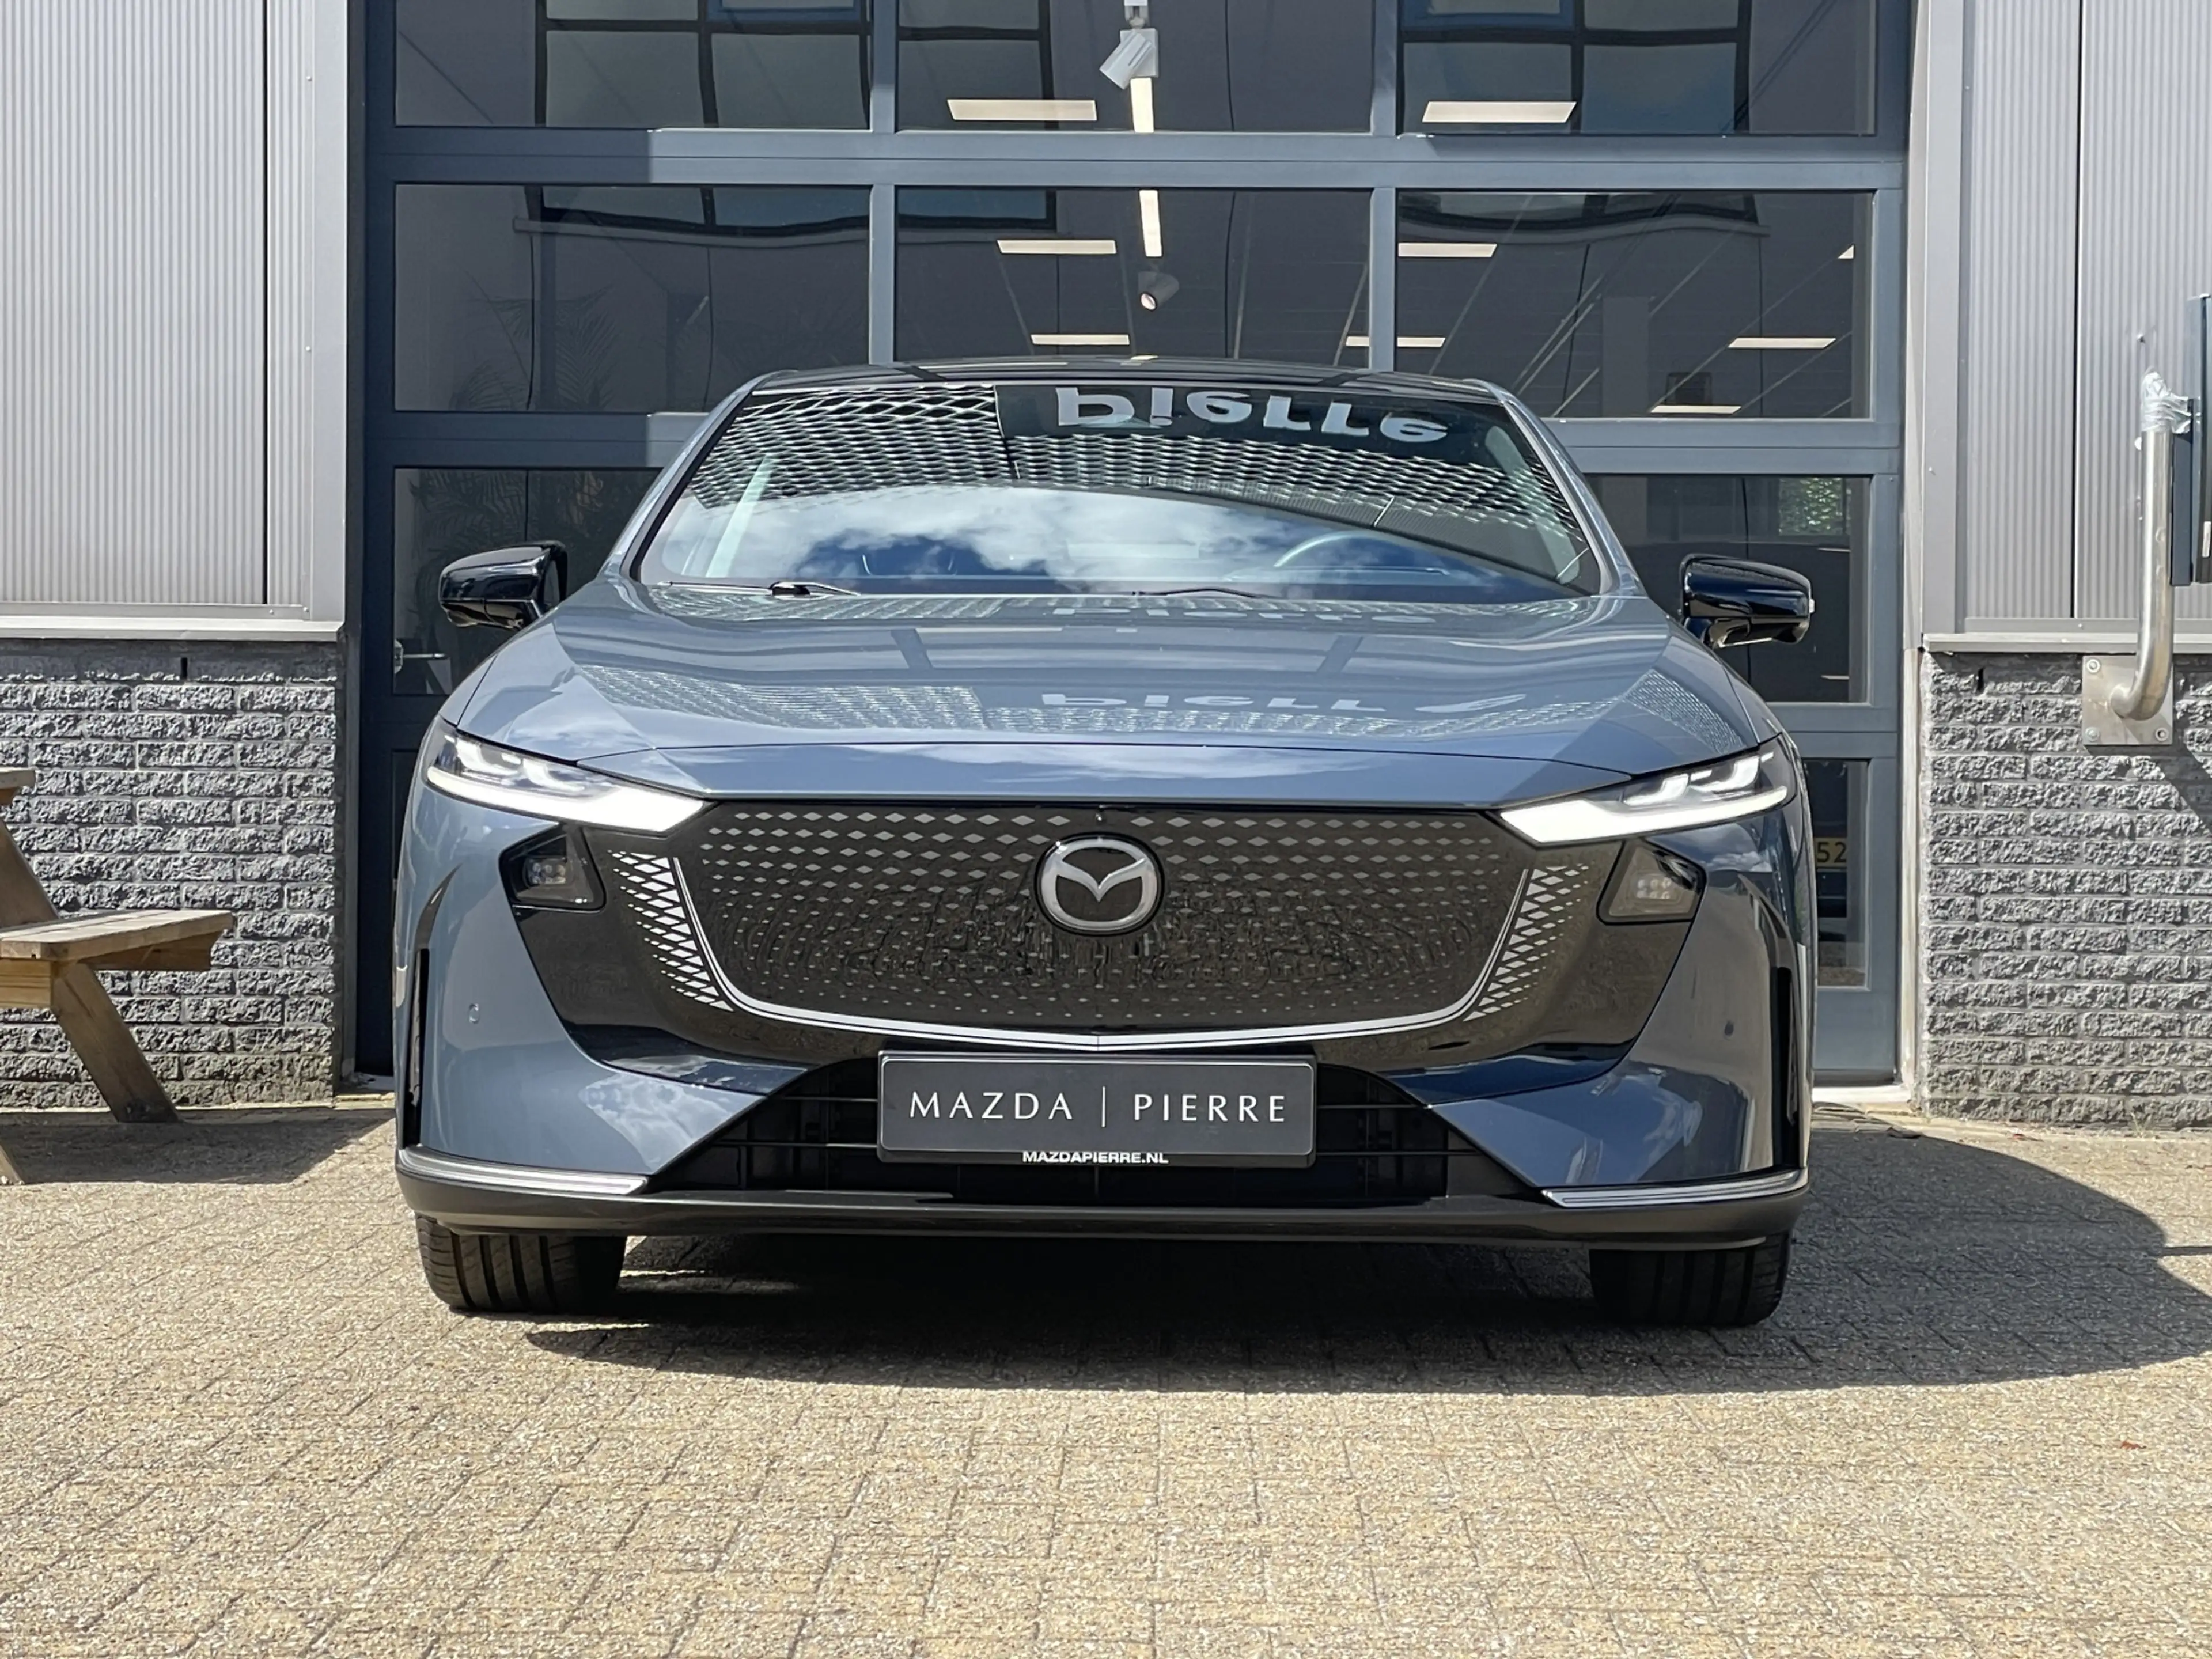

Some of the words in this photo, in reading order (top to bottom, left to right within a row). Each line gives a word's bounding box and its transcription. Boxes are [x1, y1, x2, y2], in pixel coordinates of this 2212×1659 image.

[909, 1092, 1073, 1120] MAZDA
[1134, 1094, 1285, 1122] PIERRE
[1022, 1150, 1169, 1164] MAZDAPIERRE.NL
